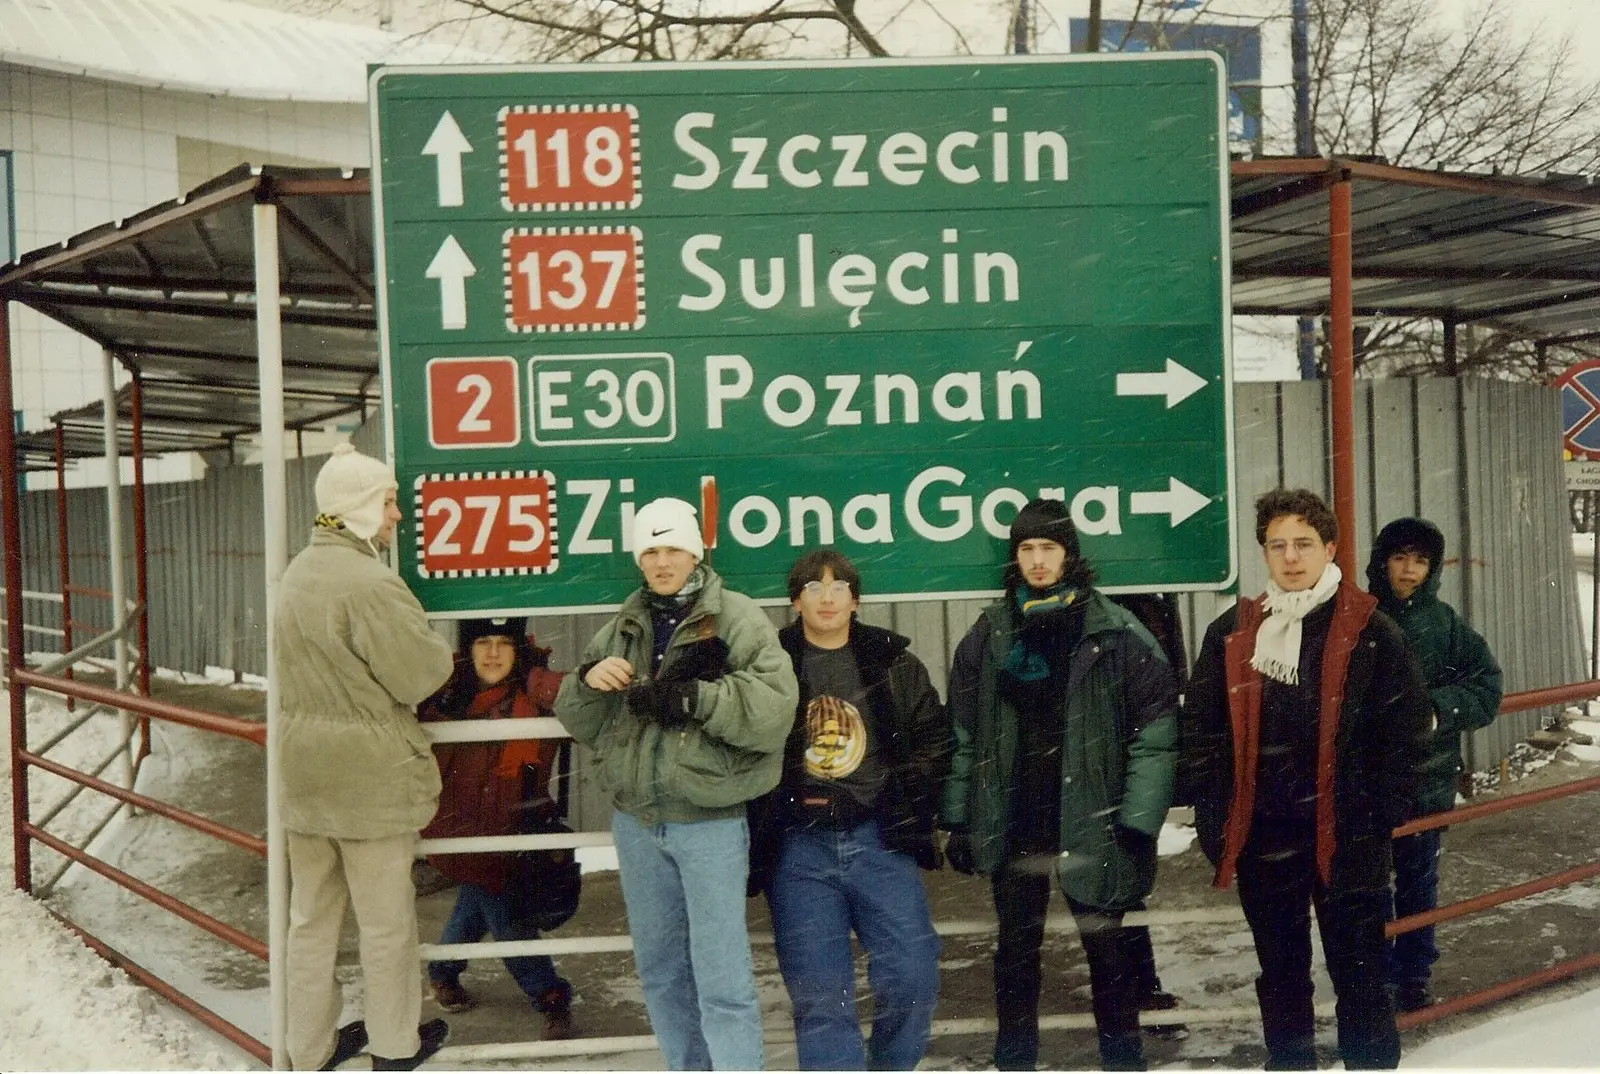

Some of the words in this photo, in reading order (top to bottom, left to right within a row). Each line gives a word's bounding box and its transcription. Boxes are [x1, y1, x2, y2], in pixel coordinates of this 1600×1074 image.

[513, 126, 624, 190] 118
[671, 106, 1069, 191] Szczecin
[517, 248, 628, 312] 137
[677, 228, 1020, 329] Sulęcin
[457, 374, 492, 433] 2
[705, 340, 1043, 430] Poznań
[427, 494, 546, 556] 275
[903, 465, 1123, 543] Goa
